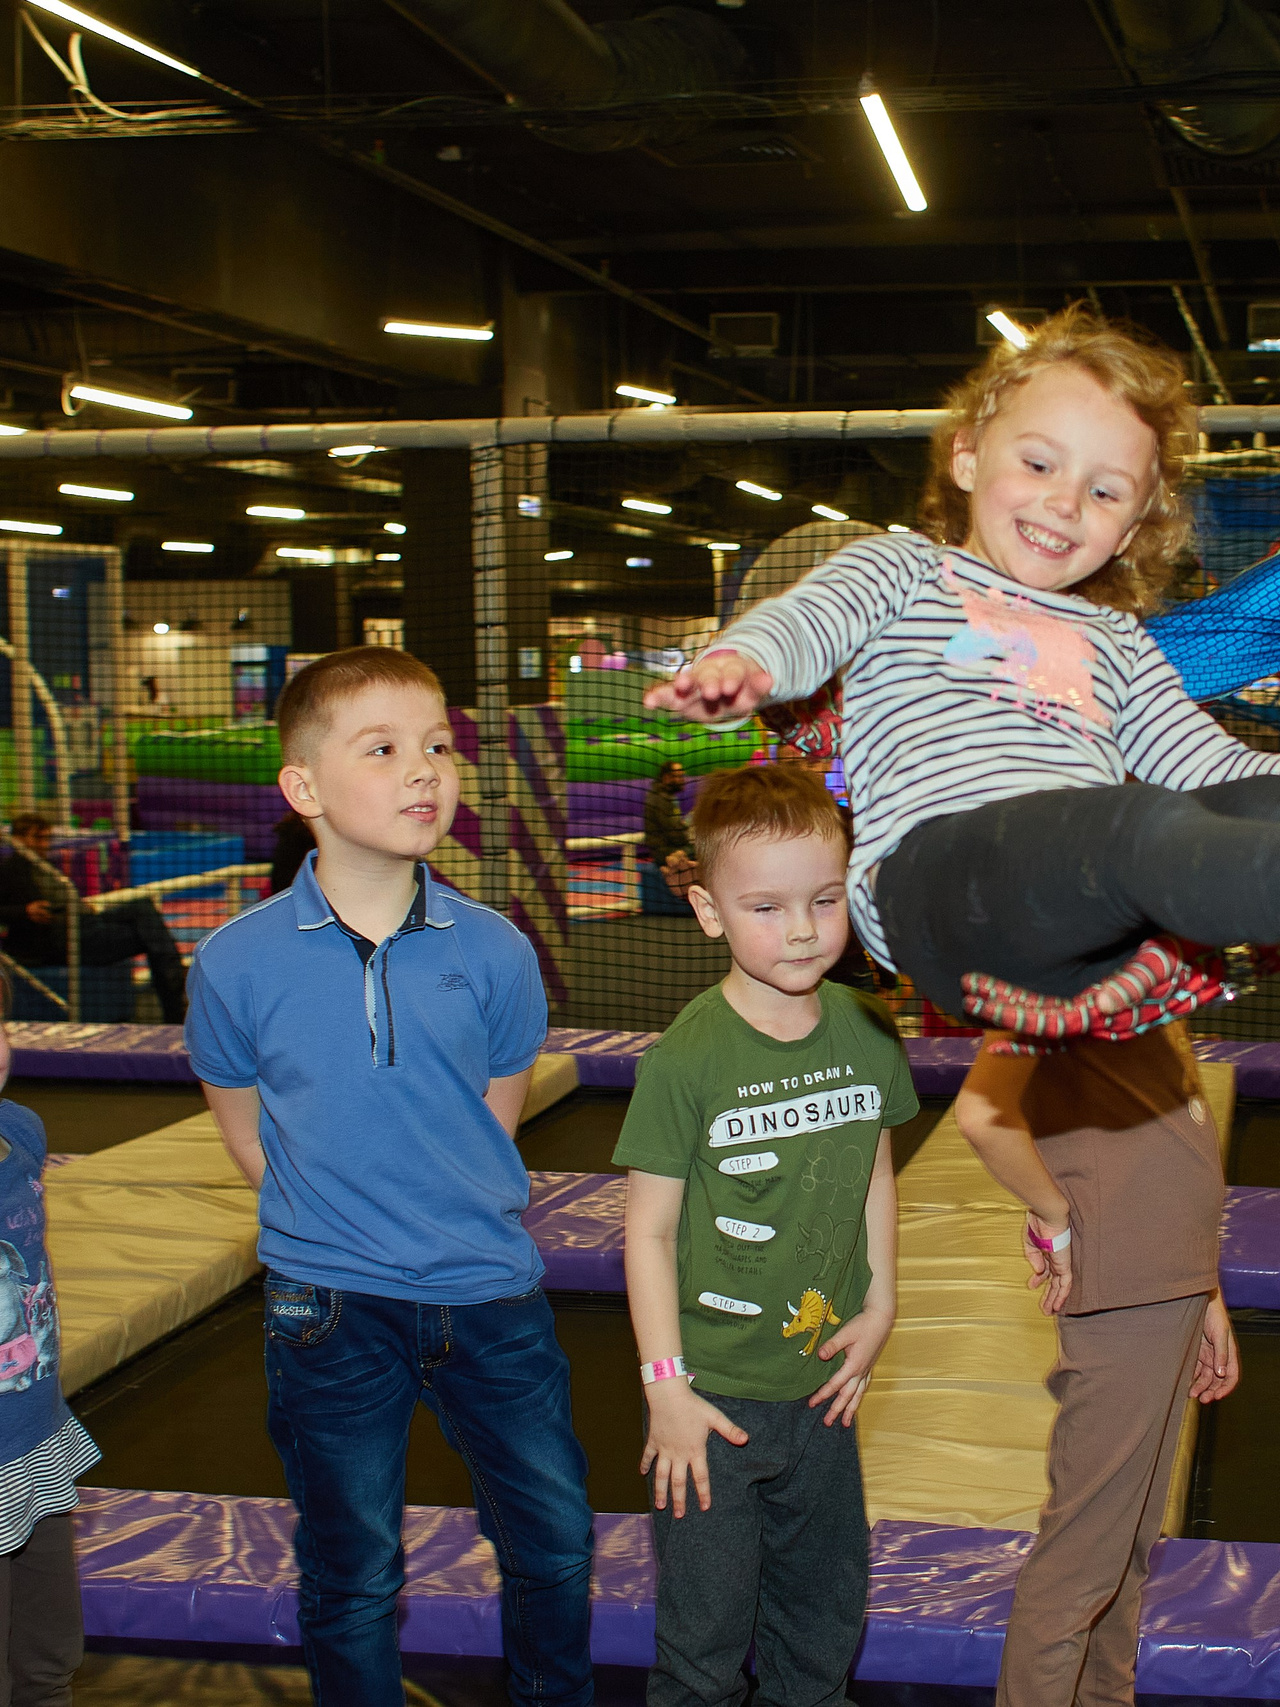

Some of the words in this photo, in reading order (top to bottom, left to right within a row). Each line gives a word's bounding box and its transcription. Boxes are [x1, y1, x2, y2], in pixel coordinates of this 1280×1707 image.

[737, 1081, 774, 1098] HOW
[780, 1076, 799, 1090] TO
[803, 1066, 840, 1086] DRAW
[845, 1064, 854, 1076] A
[726, 1091, 876, 1139] DINOSAUR!
[729, 1157, 751, 1171] STEP
[758, 1156, 763, 1167] 1
[725, 1220, 747, 1236] STEP
[752, 1227, 760, 1238] 2
[712, 1296, 735, 1310] STEP
[741, 1303, 747, 1312] 3
